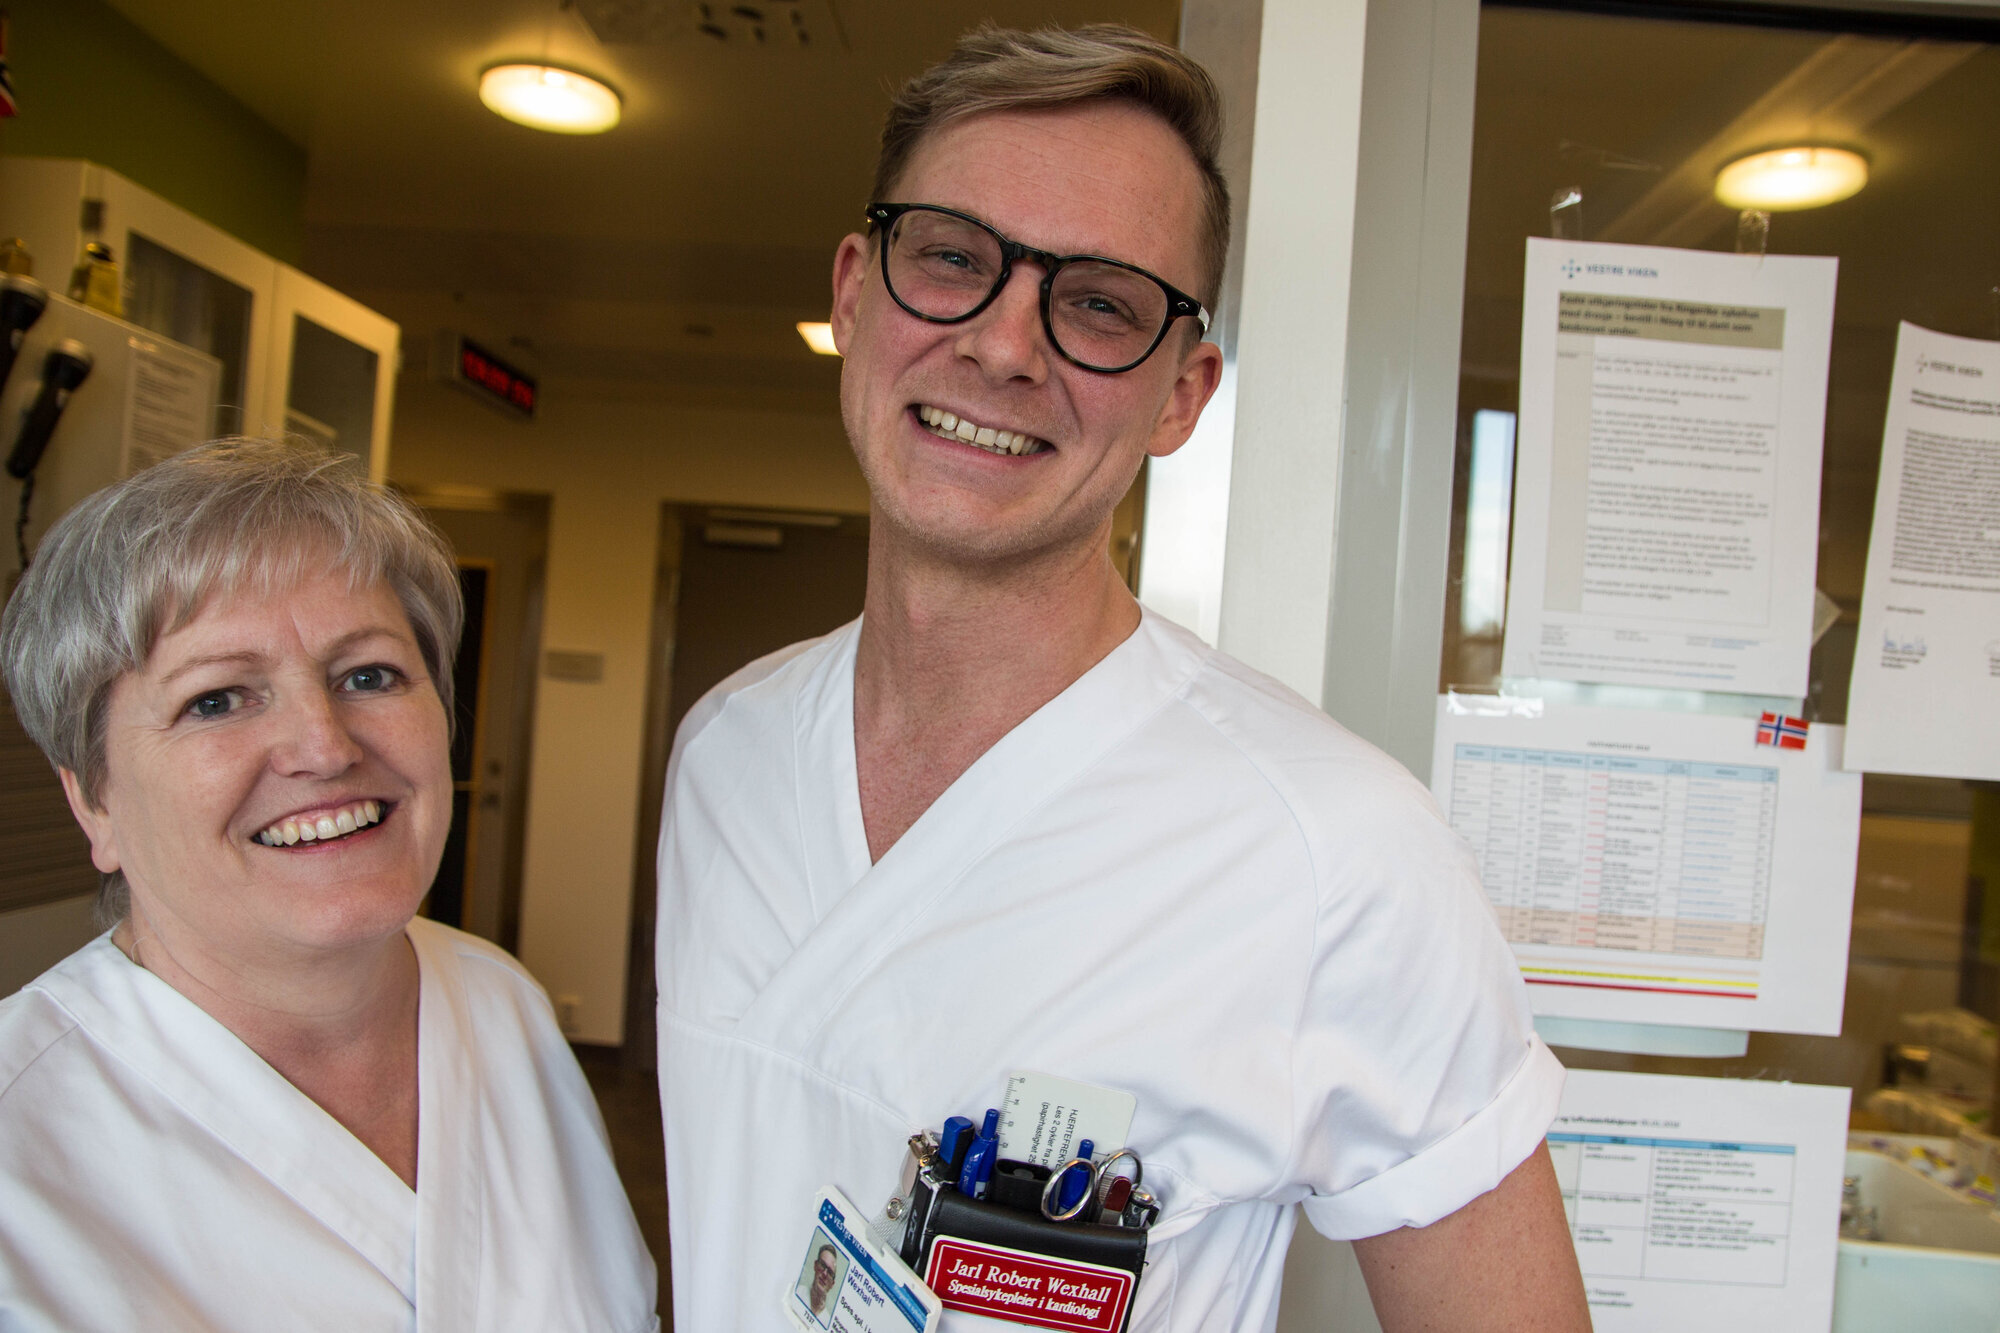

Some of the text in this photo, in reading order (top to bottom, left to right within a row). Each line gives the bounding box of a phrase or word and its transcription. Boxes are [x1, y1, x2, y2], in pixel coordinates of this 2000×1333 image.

[1054, 1105, 1064, 1119] Les
[1045, 1147, 1054, 1159] fra
[1049, 1126, 1059, 1147] cykler
[847, 1274, 872, 1307] Wexhall
[850, 1266, 885, 1307] Jarl Robert
[947, 1259, 1112, 1303] Jarl Robert Wexhall
[948, 1279, 1102, 1320] Spesialsykepleier i kardiologi
